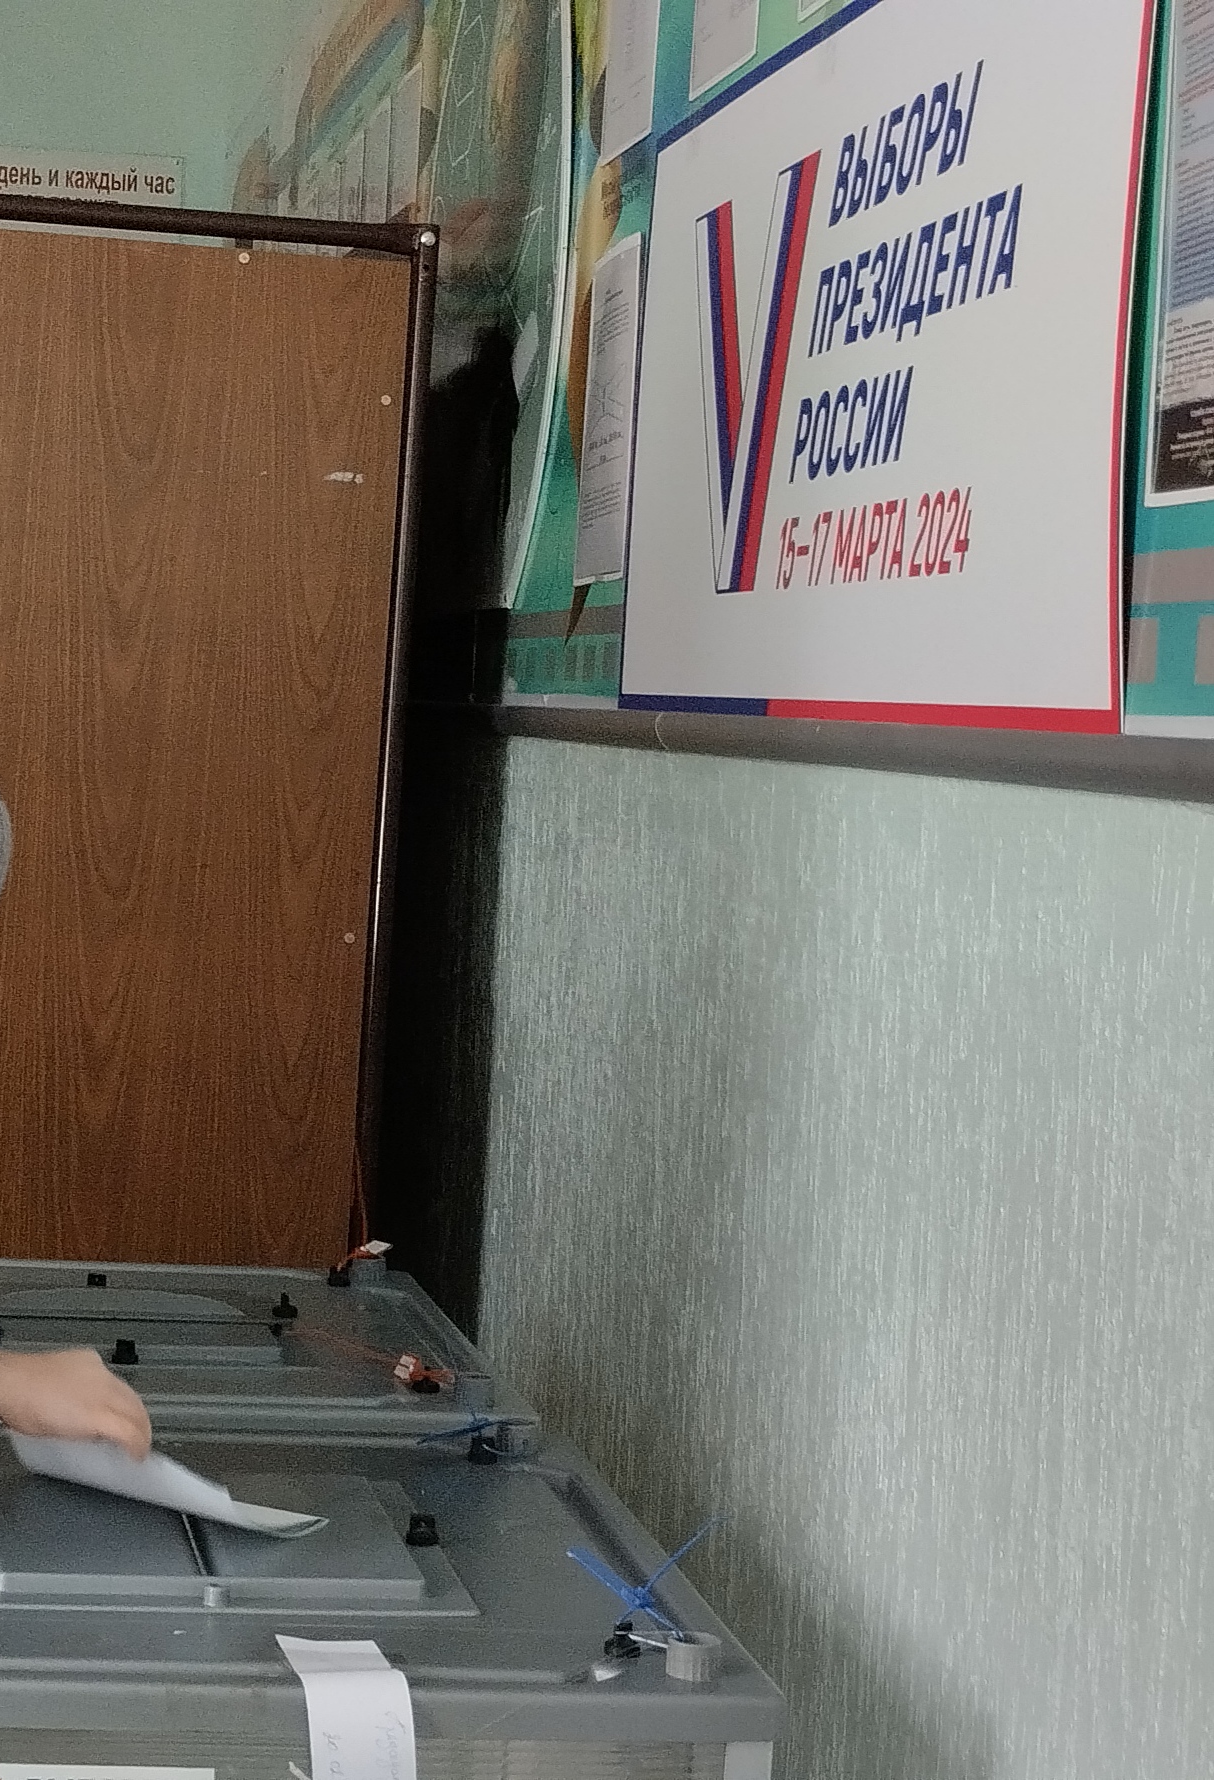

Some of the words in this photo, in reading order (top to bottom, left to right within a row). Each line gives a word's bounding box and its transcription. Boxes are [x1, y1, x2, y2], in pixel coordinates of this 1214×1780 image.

[48, 168, 60, 187] и
[65, 166, 138, 195] каждый
[144, 174, 176, 195] час
[828, 59, 984, 228] ВЫБОРЫ
[807, 182, 1023, 358] ПРЕЗИДЕНТА
[789, 365, 915, 484] РОССИИ
[830, 497, 908, 585] МАРТА
[908, 486, 972, 578] 2024
